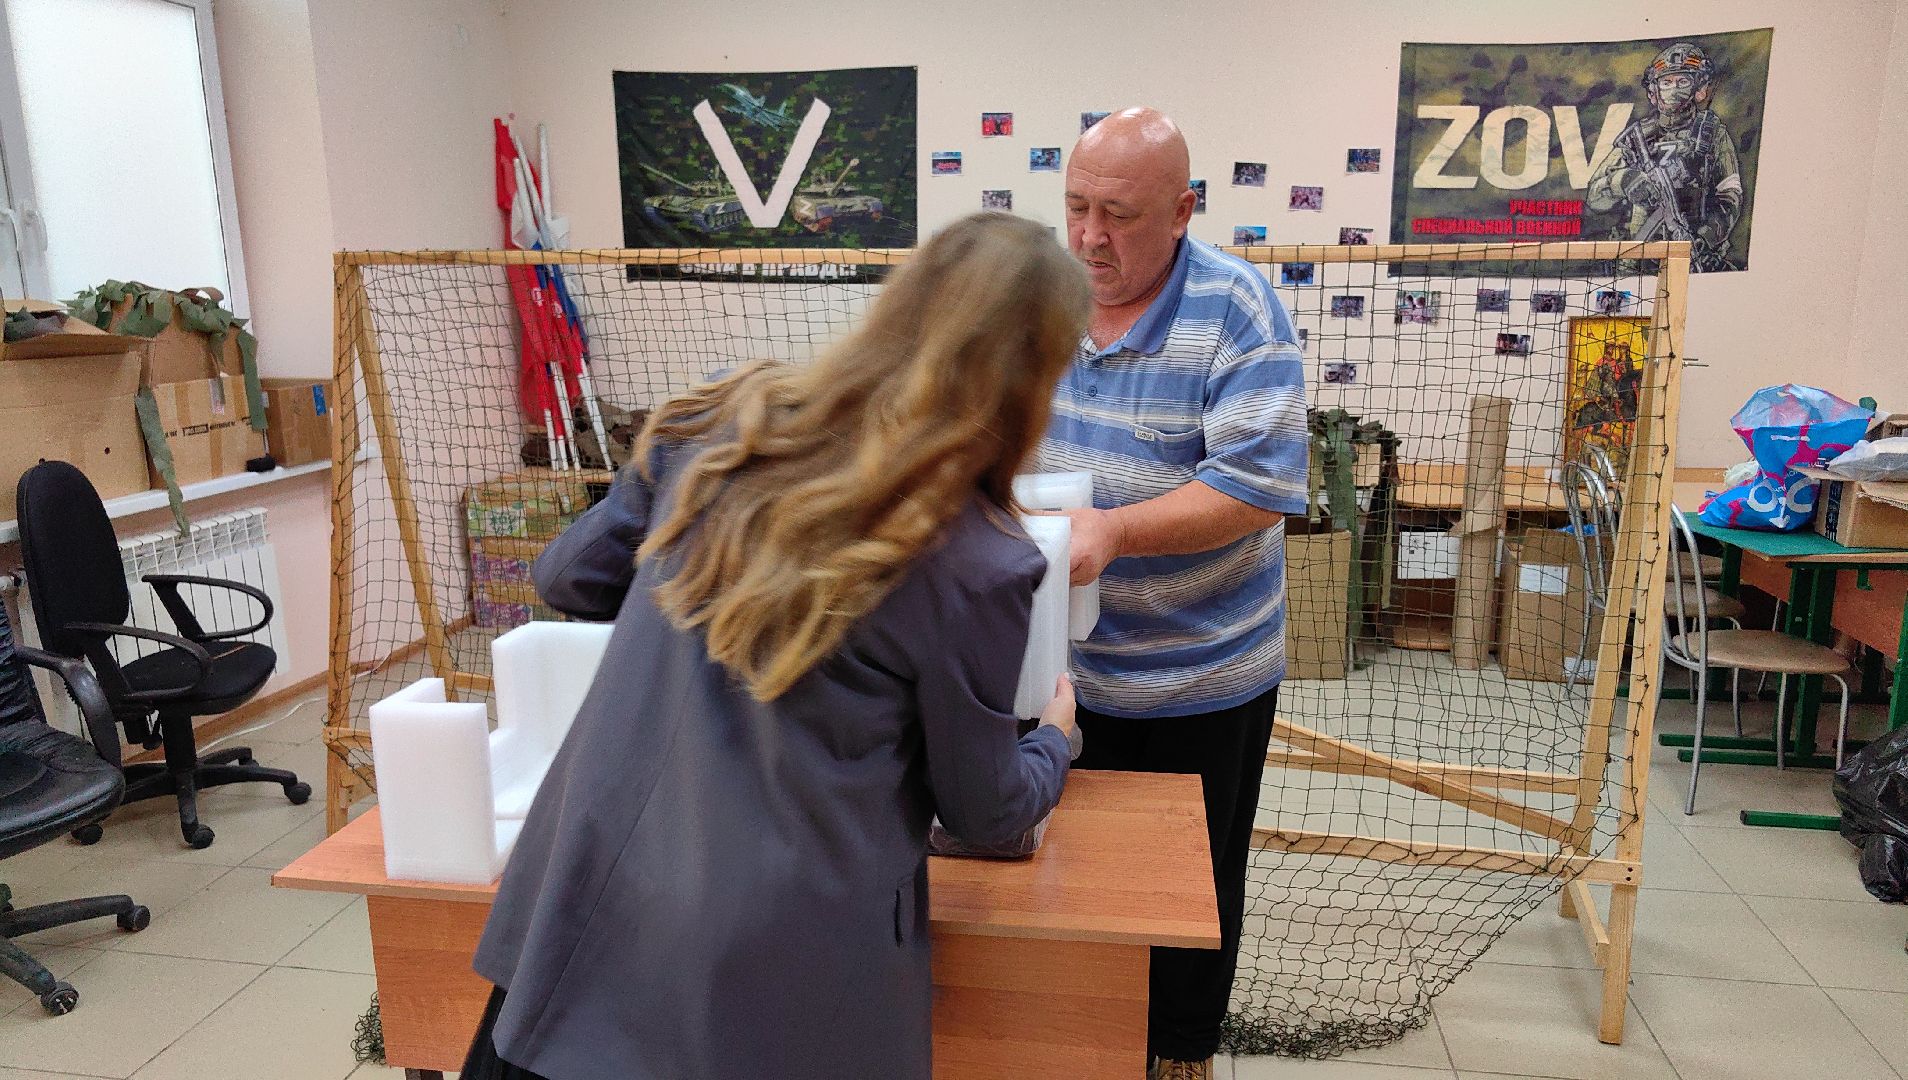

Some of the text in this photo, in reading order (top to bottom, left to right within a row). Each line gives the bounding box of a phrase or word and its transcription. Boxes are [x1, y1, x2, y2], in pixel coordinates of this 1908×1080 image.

[693, 97, 831, 228] V
[1413, 103, 1634, 189] ZOV
[1411, 217, 1581, 235] СПЕЦИАЛЬНОЙ ВОЕННОЙ
[1510, 199, 1583, 215] УЧАСТНИК
